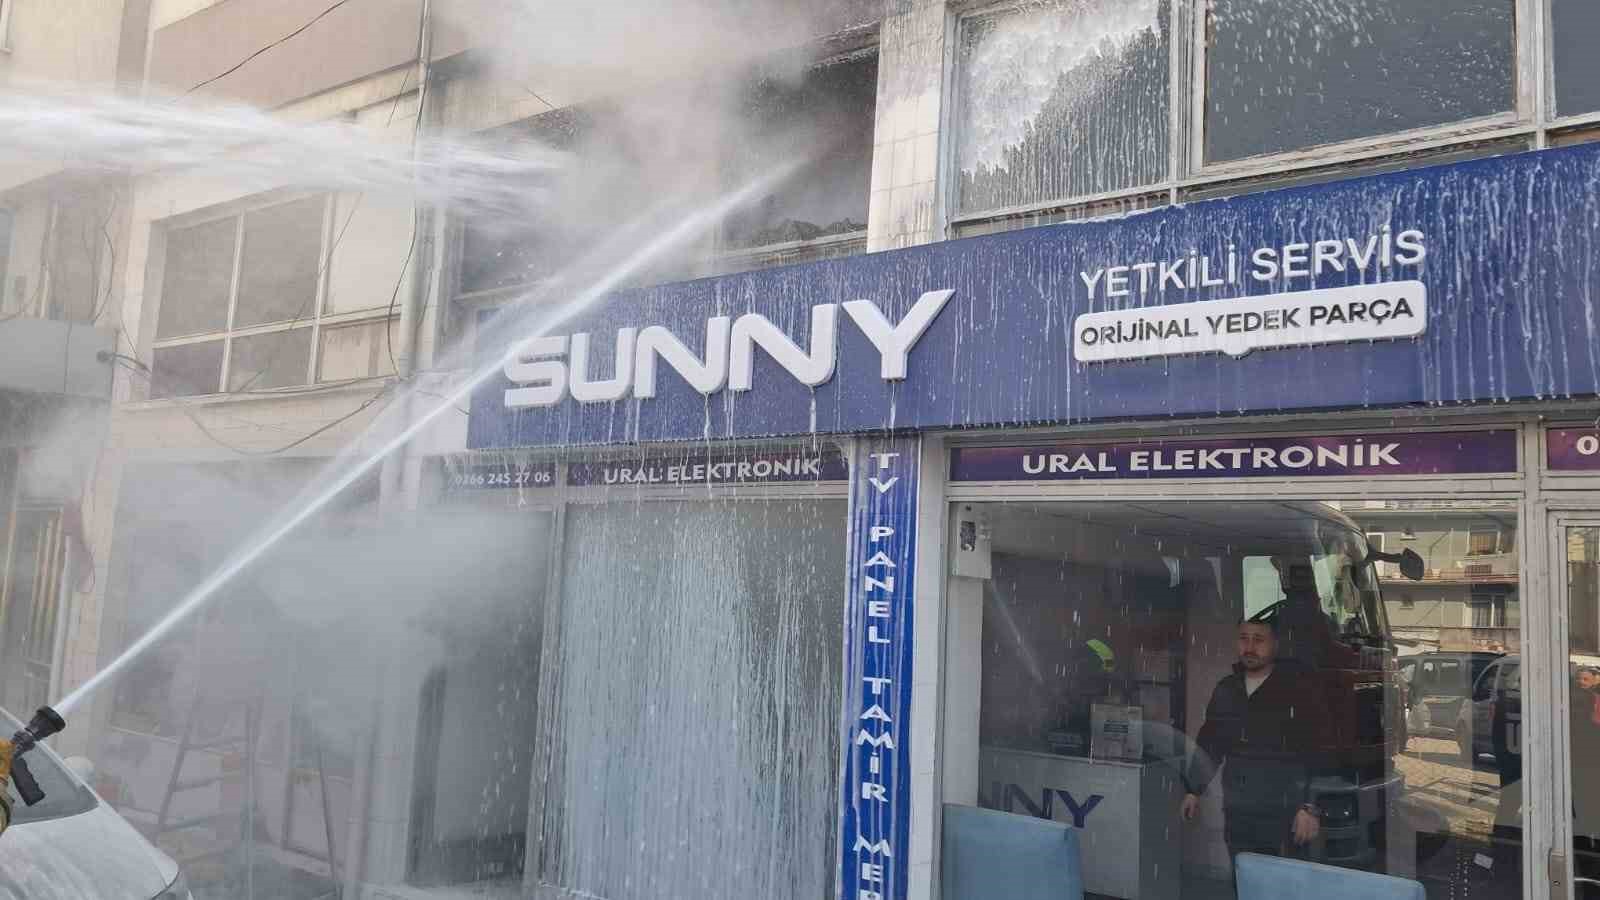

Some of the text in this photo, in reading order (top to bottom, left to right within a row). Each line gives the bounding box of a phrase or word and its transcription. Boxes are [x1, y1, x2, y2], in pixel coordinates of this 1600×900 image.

[1080, 224, 1426, 299] YETKİLİ SERVİS
[1080, 297, 1414, 347] ORİJİNAL YEDEK PARÇA
[503, 288, 956, 408] SUNNY
[534, 471, 551, 483] 06
[604, 467, 661, 484] URAL
[868, 452, 900, 493] TV
[1022, 438, 1400, 474] URAL ELEKTRONİK
[863, 526, 897, 644] PANEL
[856, 676, 896, 802] TAMİR
